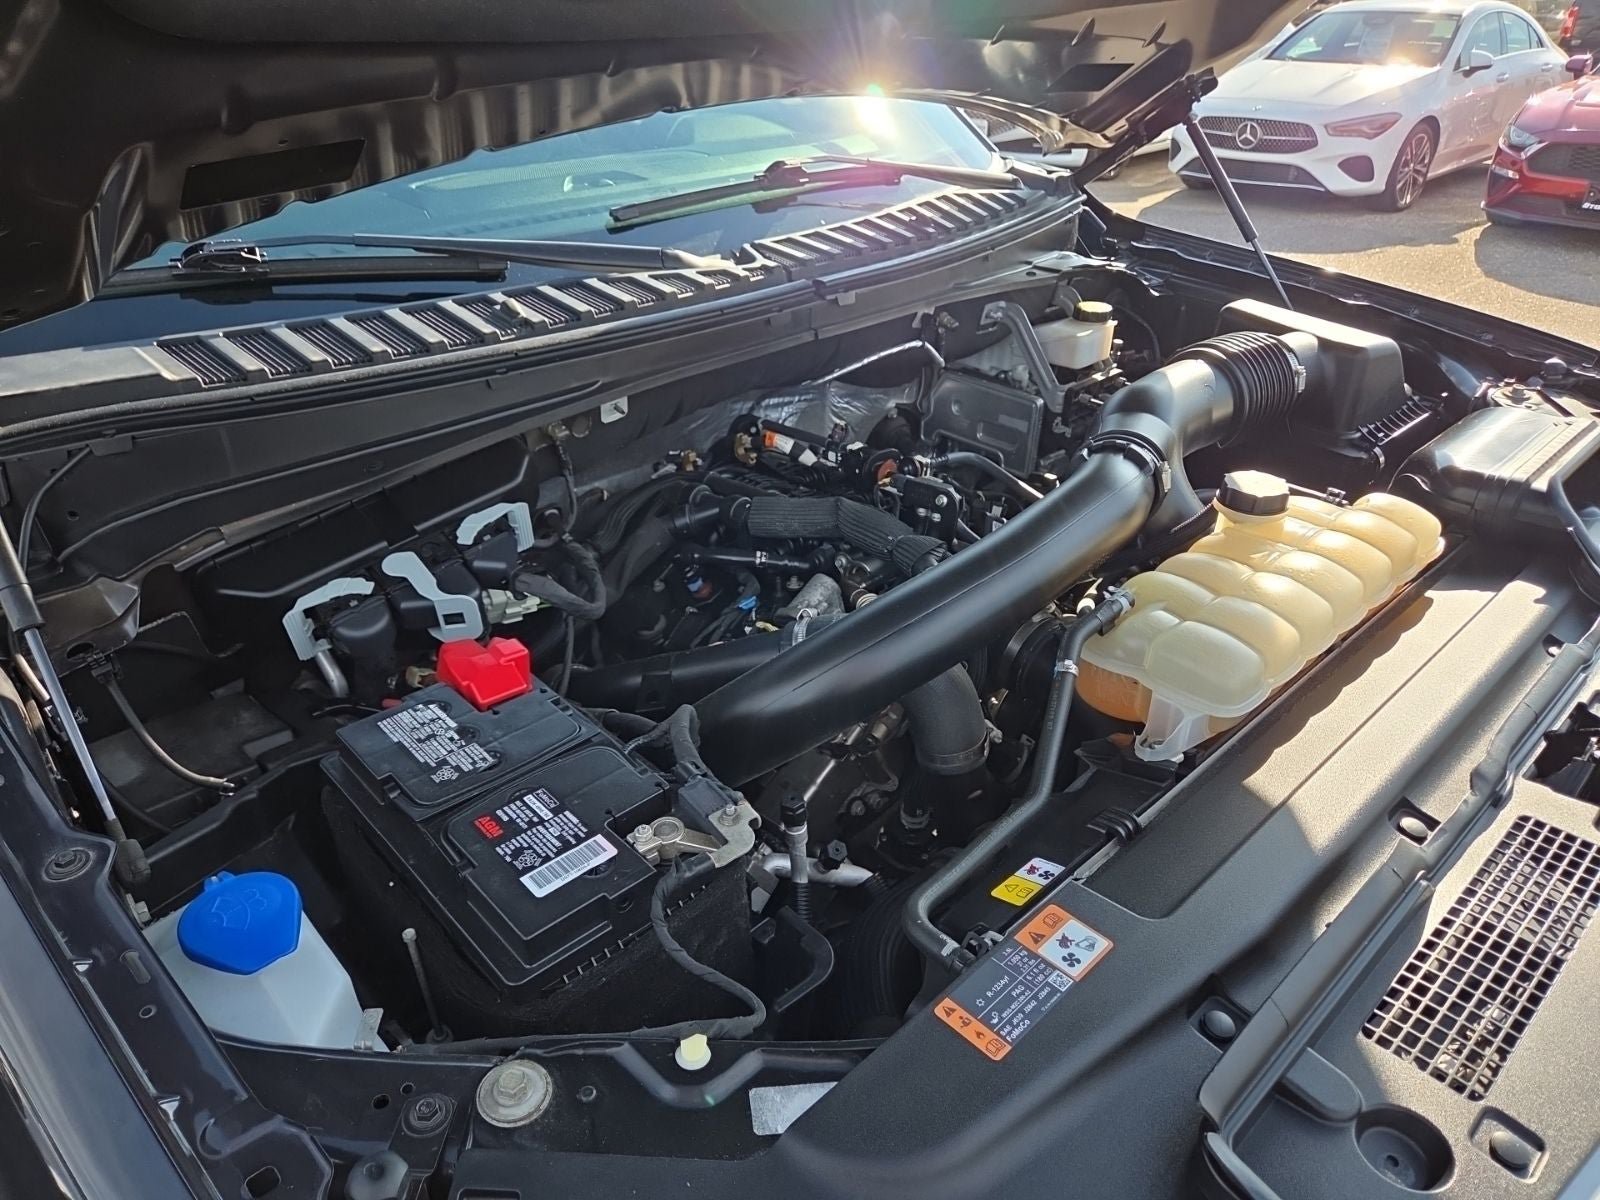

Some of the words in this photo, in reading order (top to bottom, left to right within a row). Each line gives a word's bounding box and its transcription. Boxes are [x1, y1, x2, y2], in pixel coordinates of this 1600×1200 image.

[478, 816, 503, 837] AGM
[1019, 949, 1028, 957] kg
[986, 975, 1010, 998] R-1234yf
[1011, 985, 1025, 997] PAG
[1000, 1024, 1012, 1036] SAE
[1006, 1019, 1031, 1042] FoMoCo
